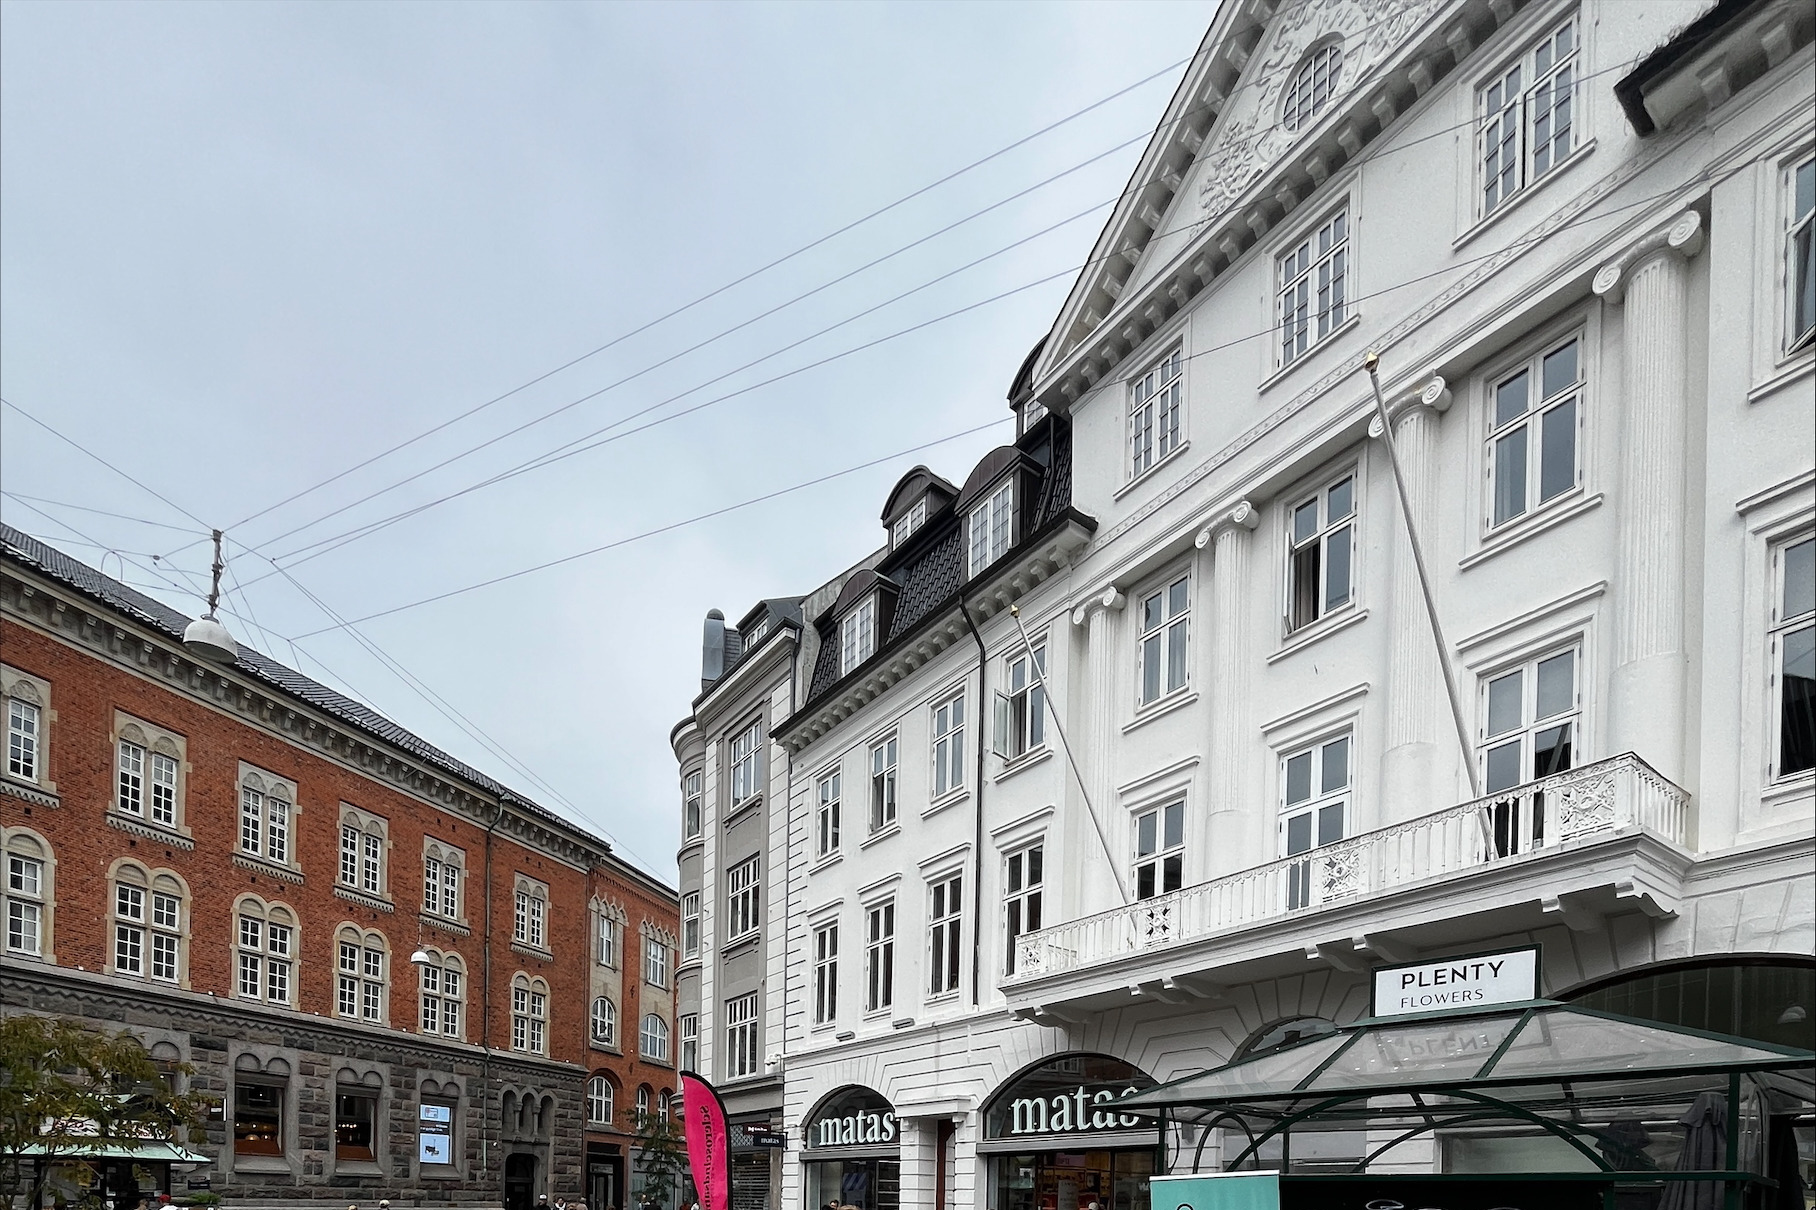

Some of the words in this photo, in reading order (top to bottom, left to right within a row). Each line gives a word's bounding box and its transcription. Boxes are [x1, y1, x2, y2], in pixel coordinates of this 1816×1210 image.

[1401, 960, 1504, 989] PLENTY
[1401, 988, 1484, 1008] FLOWERS
[818, 1109, 895, 1146] matas
